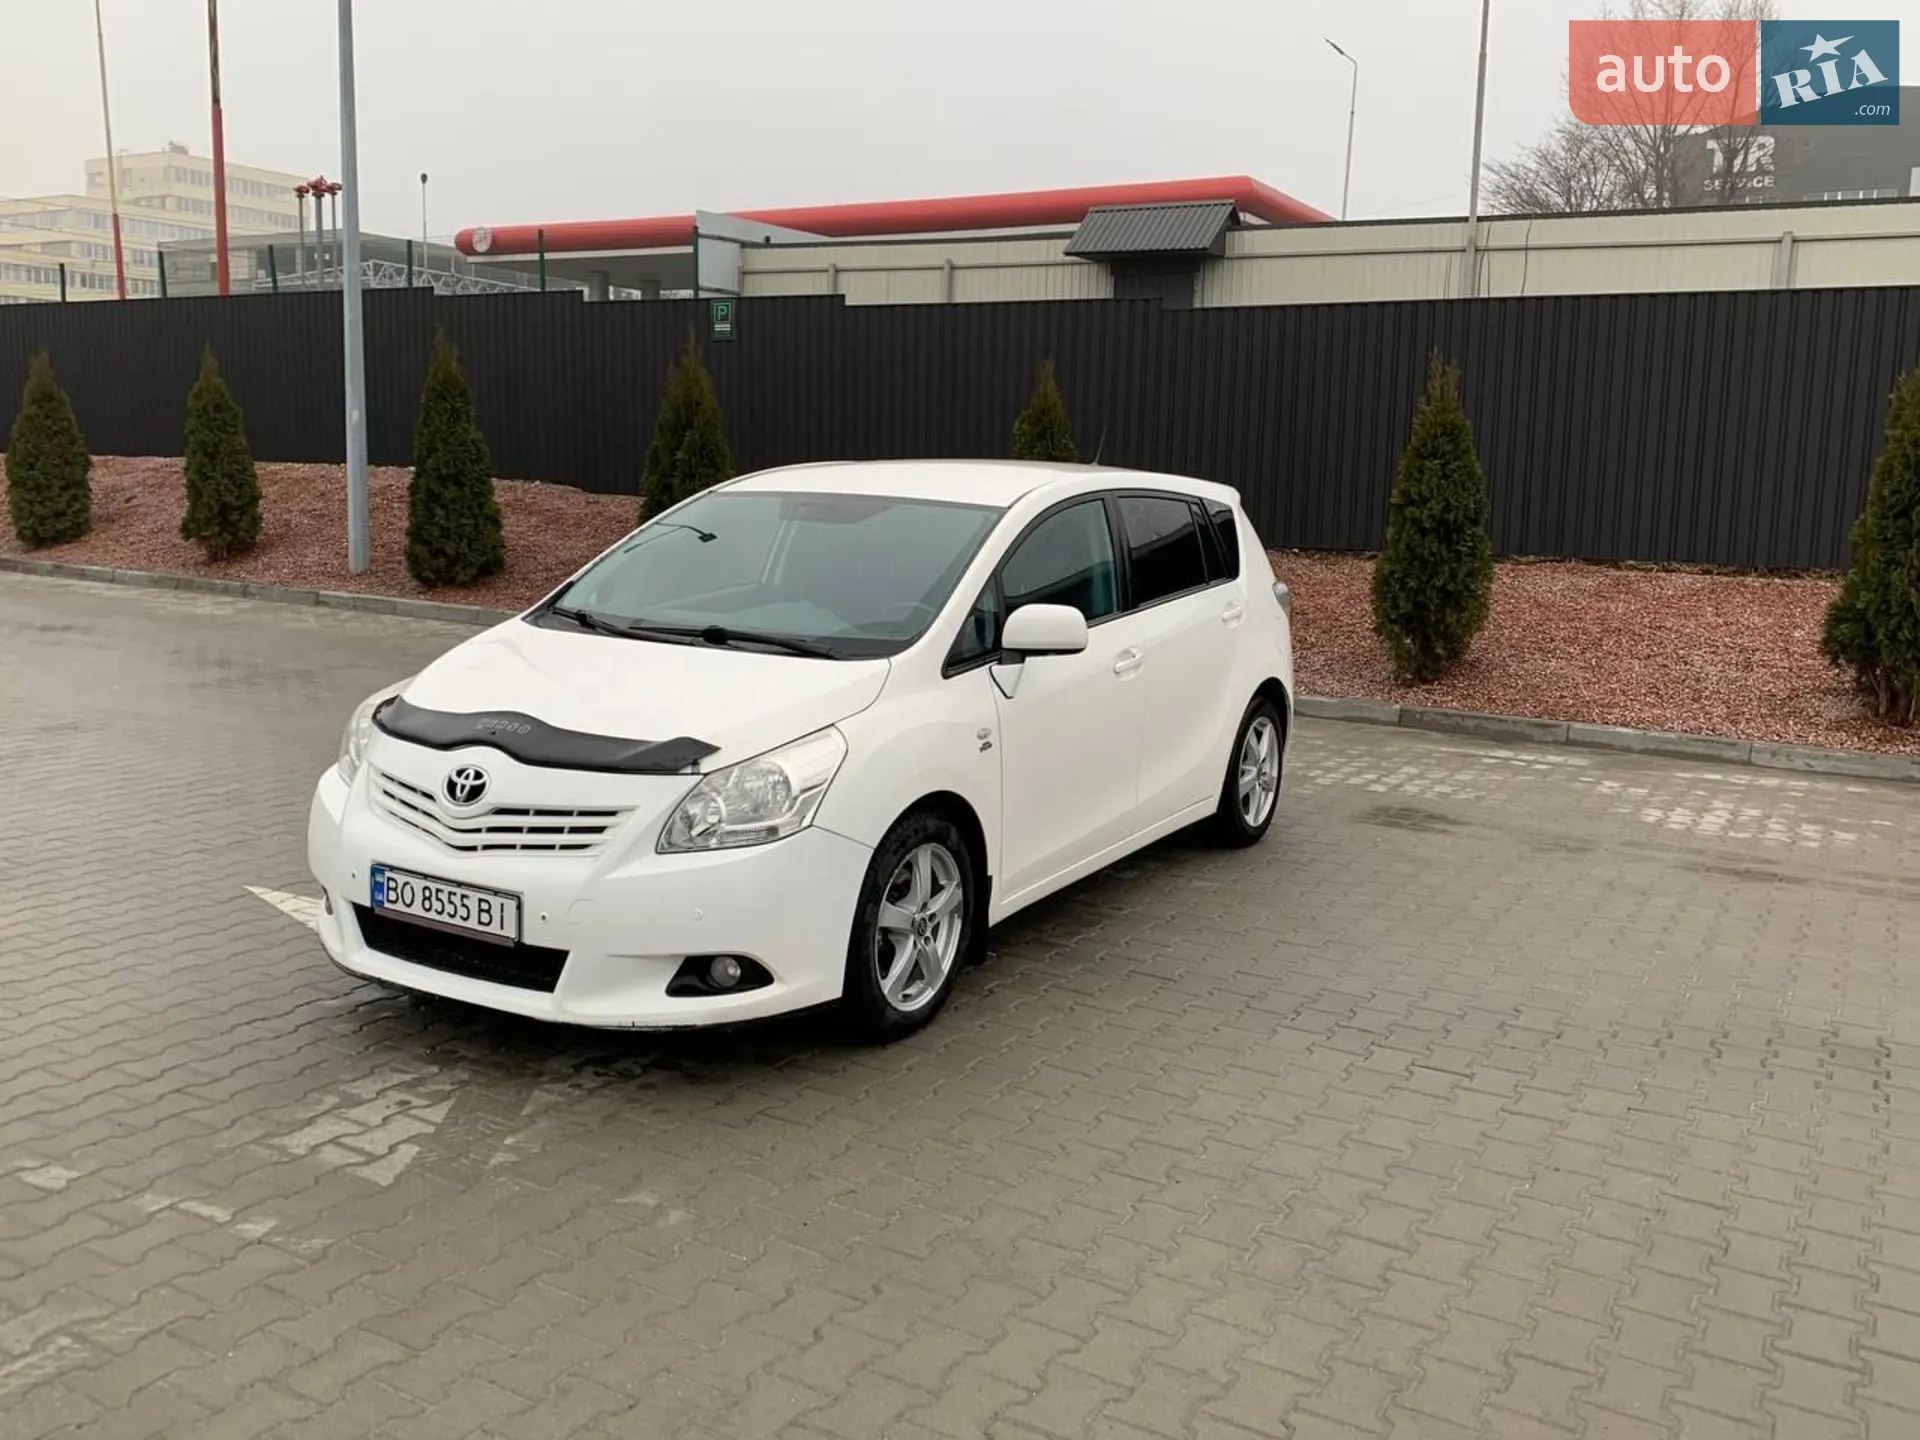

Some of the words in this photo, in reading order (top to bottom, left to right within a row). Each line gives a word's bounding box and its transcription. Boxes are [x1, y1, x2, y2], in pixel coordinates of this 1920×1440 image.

[717, 305, 728, 321] P
[386, 876, 415, 908] BO
[421, 885, 471, 922] 8555
[477, 897, 505, 931] BI
